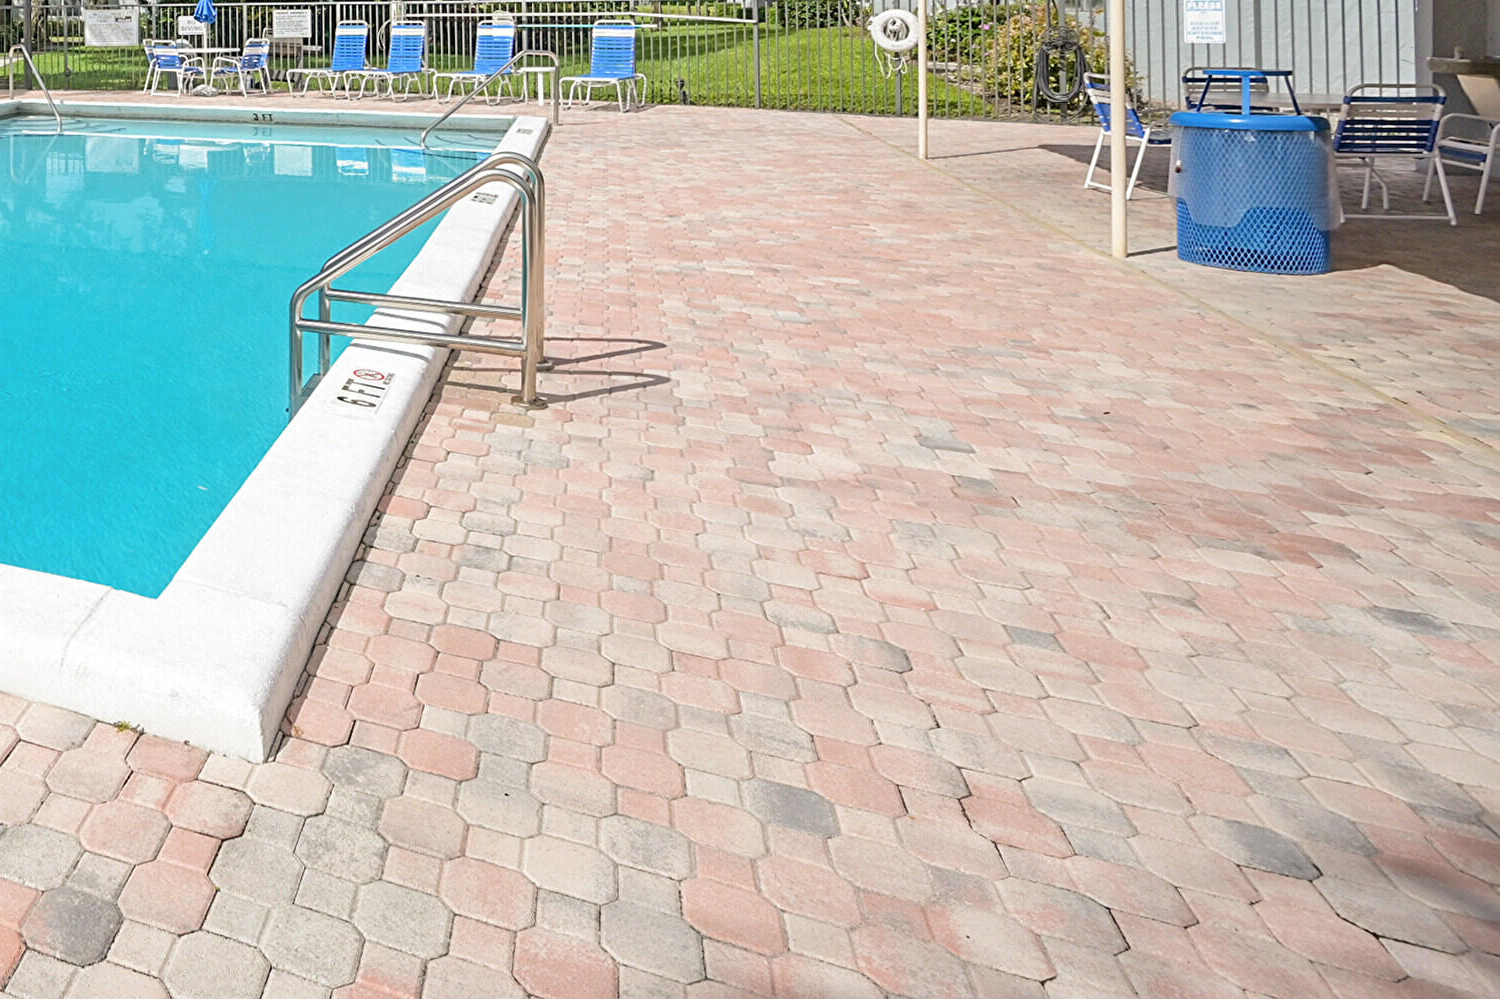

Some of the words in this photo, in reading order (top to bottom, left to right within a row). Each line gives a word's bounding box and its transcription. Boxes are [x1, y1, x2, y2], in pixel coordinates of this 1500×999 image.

[1187, 1, 1221, 9] PLEASE
[253, 112, 259, 121] 3
[262, 113, 273, 121] FT
[341, 378, 386, 398] FT
[336, 395, 377, 408] 6
